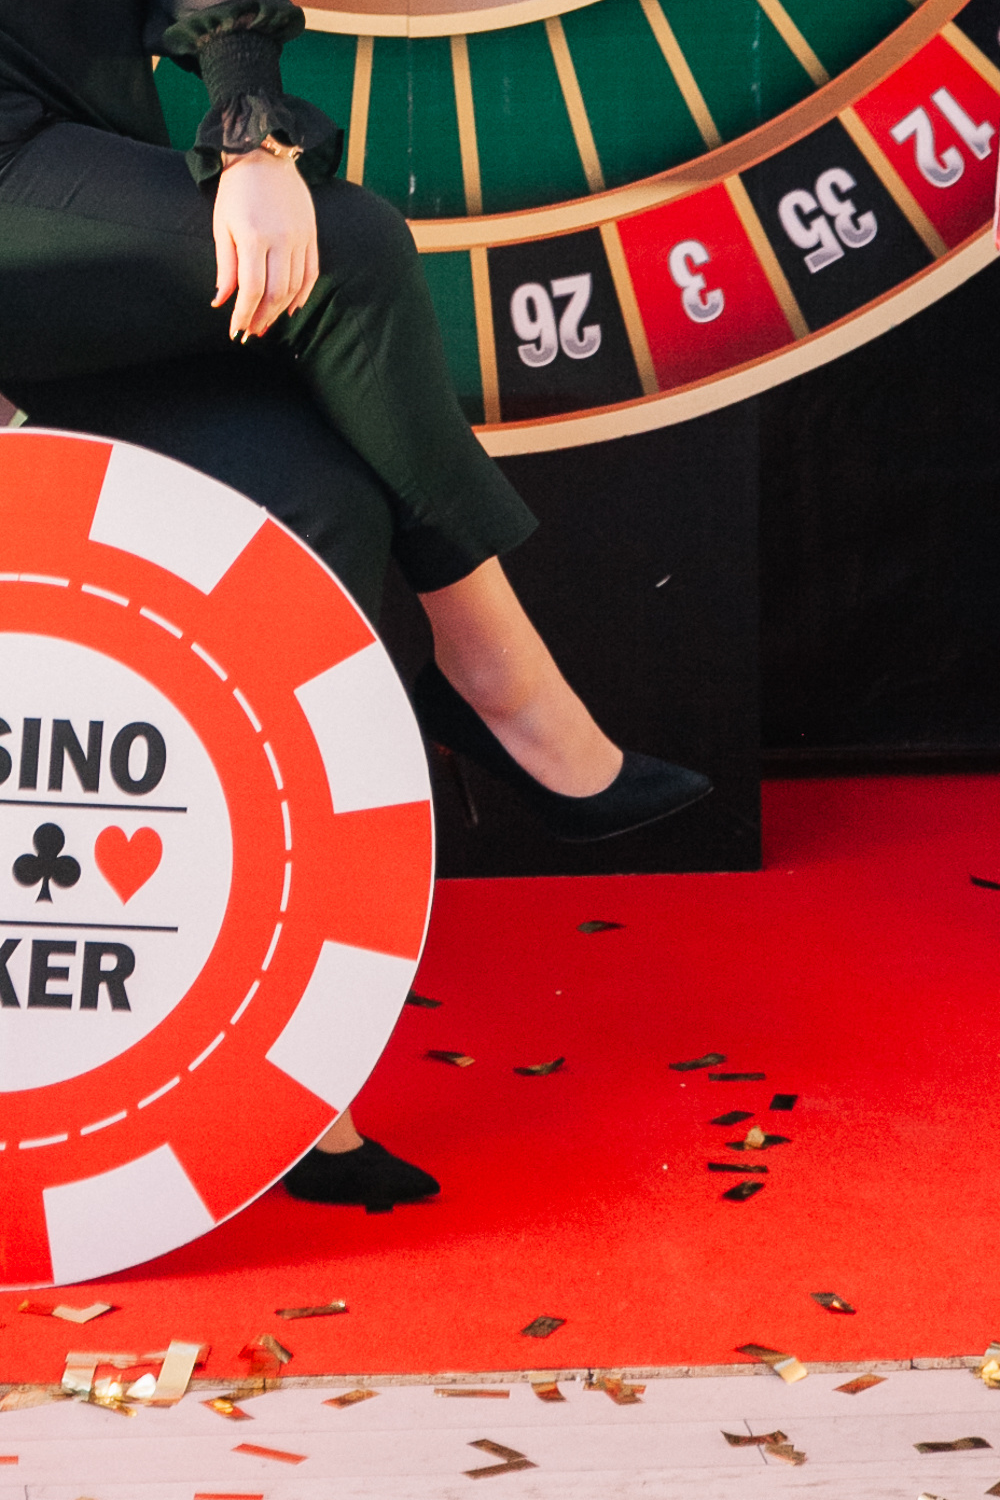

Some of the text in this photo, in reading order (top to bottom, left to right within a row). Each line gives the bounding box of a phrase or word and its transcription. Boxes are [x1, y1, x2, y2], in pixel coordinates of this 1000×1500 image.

[890, 88, 995, 188] 12
[778, 168, 878, 274] 35
[510, 273, 602, 368] 26
[669, 240, 725, 323] 3
